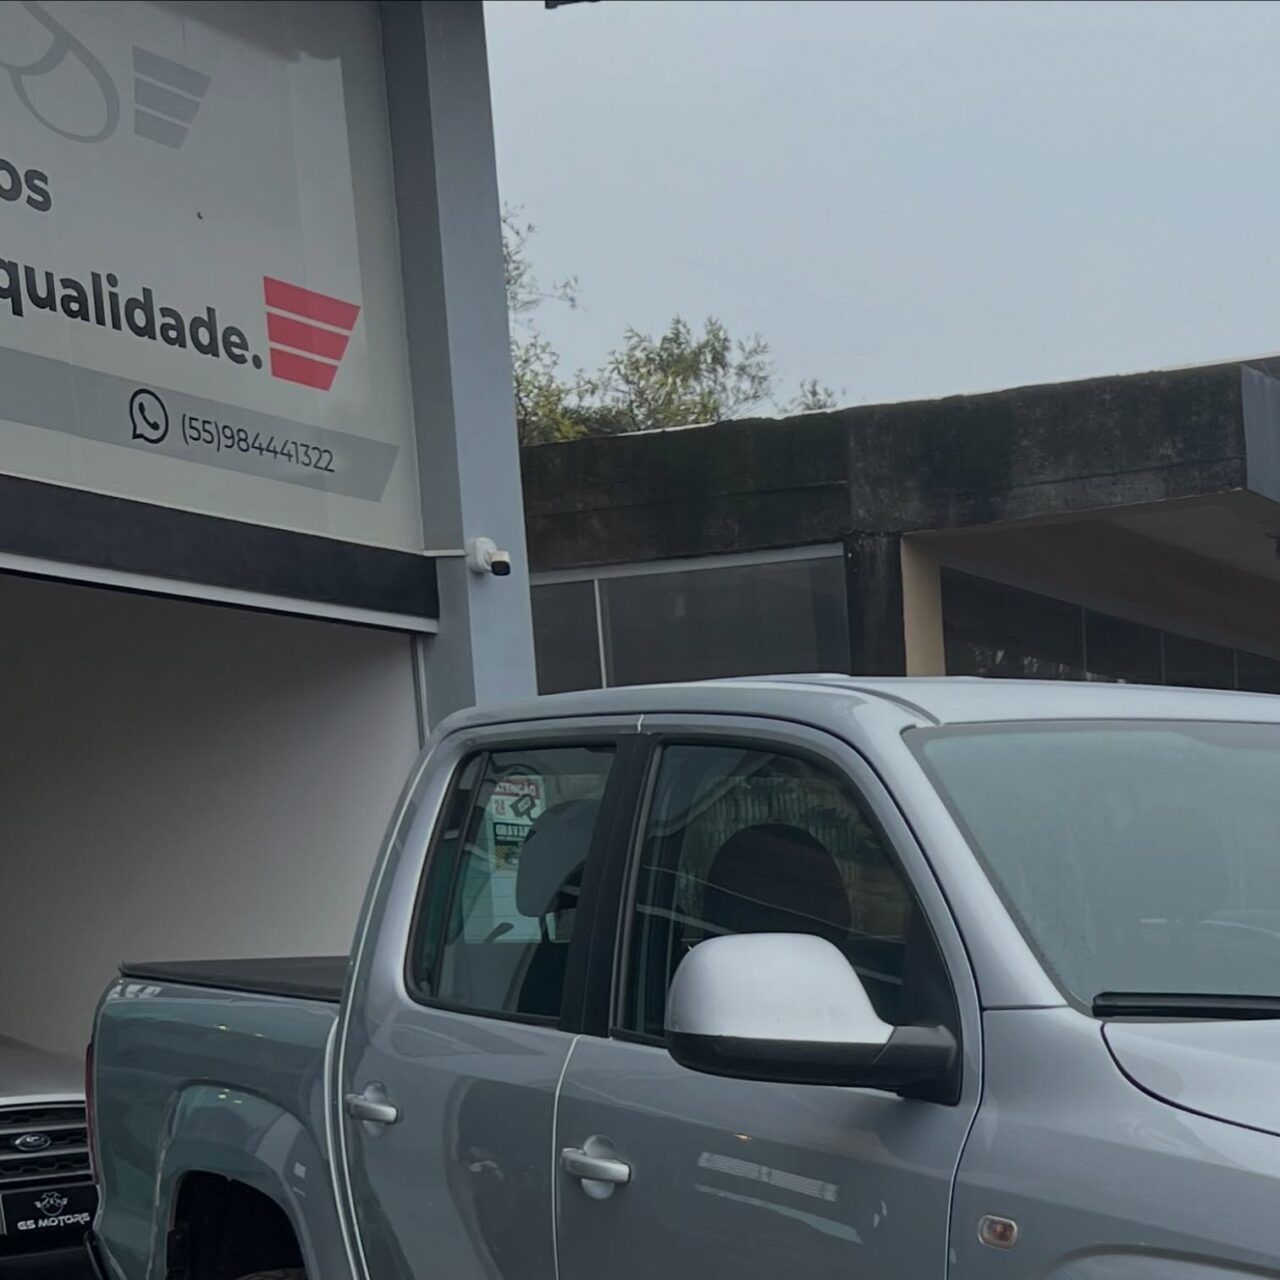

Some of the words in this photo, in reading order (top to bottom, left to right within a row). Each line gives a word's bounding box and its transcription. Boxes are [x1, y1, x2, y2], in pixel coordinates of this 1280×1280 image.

[0, 258, 263, 369] qualidade.
[182, 414, 335, 472] (55)984441322
[38, 1213, 90, 1227] MOTORS
